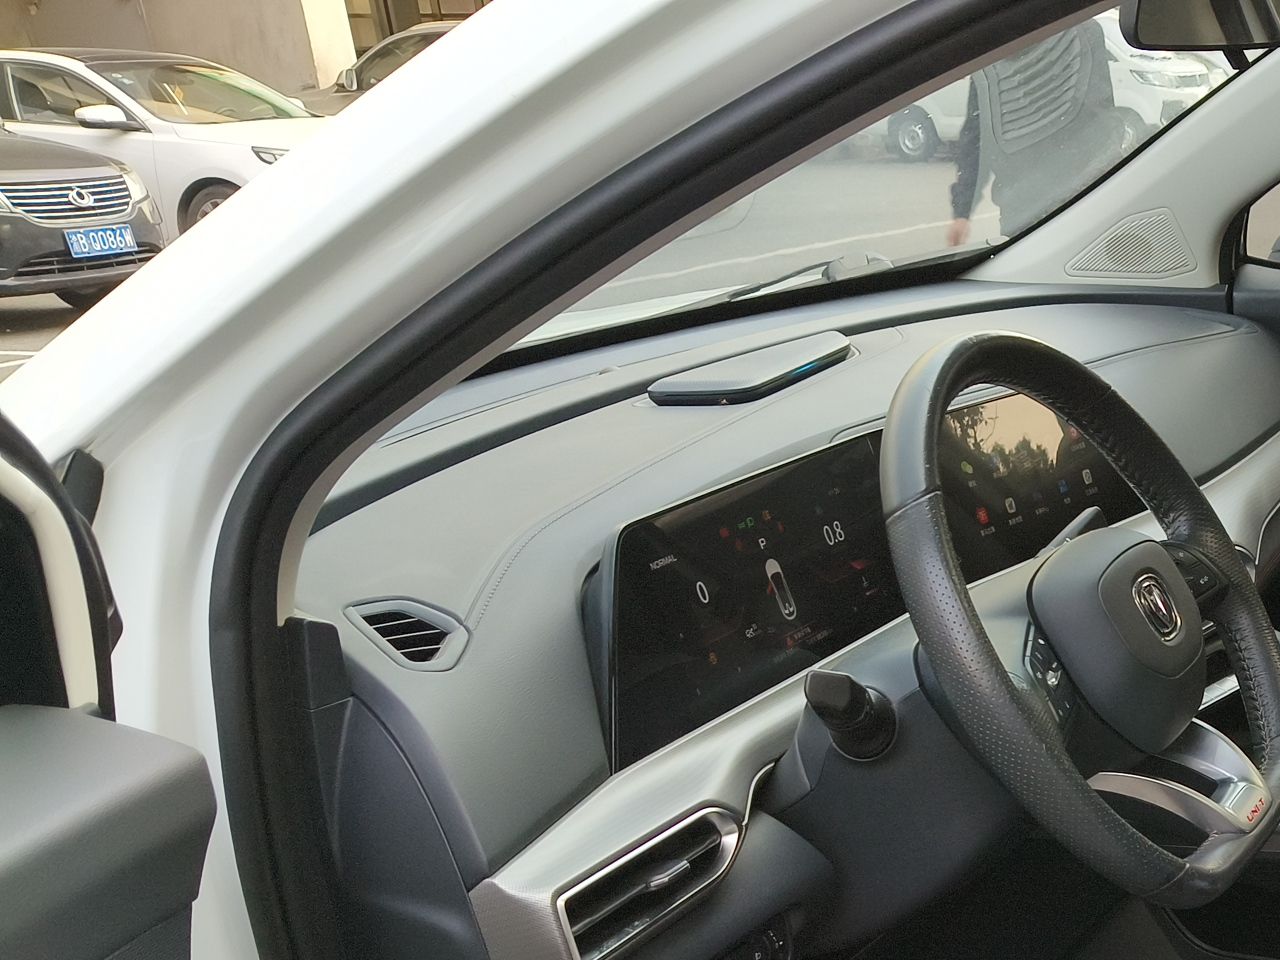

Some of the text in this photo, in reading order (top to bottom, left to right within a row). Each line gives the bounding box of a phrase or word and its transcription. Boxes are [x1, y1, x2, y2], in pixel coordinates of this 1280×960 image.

[824, 520, 845, 545] 0.8
[758, 538, 767, 549] P
[650, 554, 677, 570] NORMAL
[696, 581, 709, 604] 0
